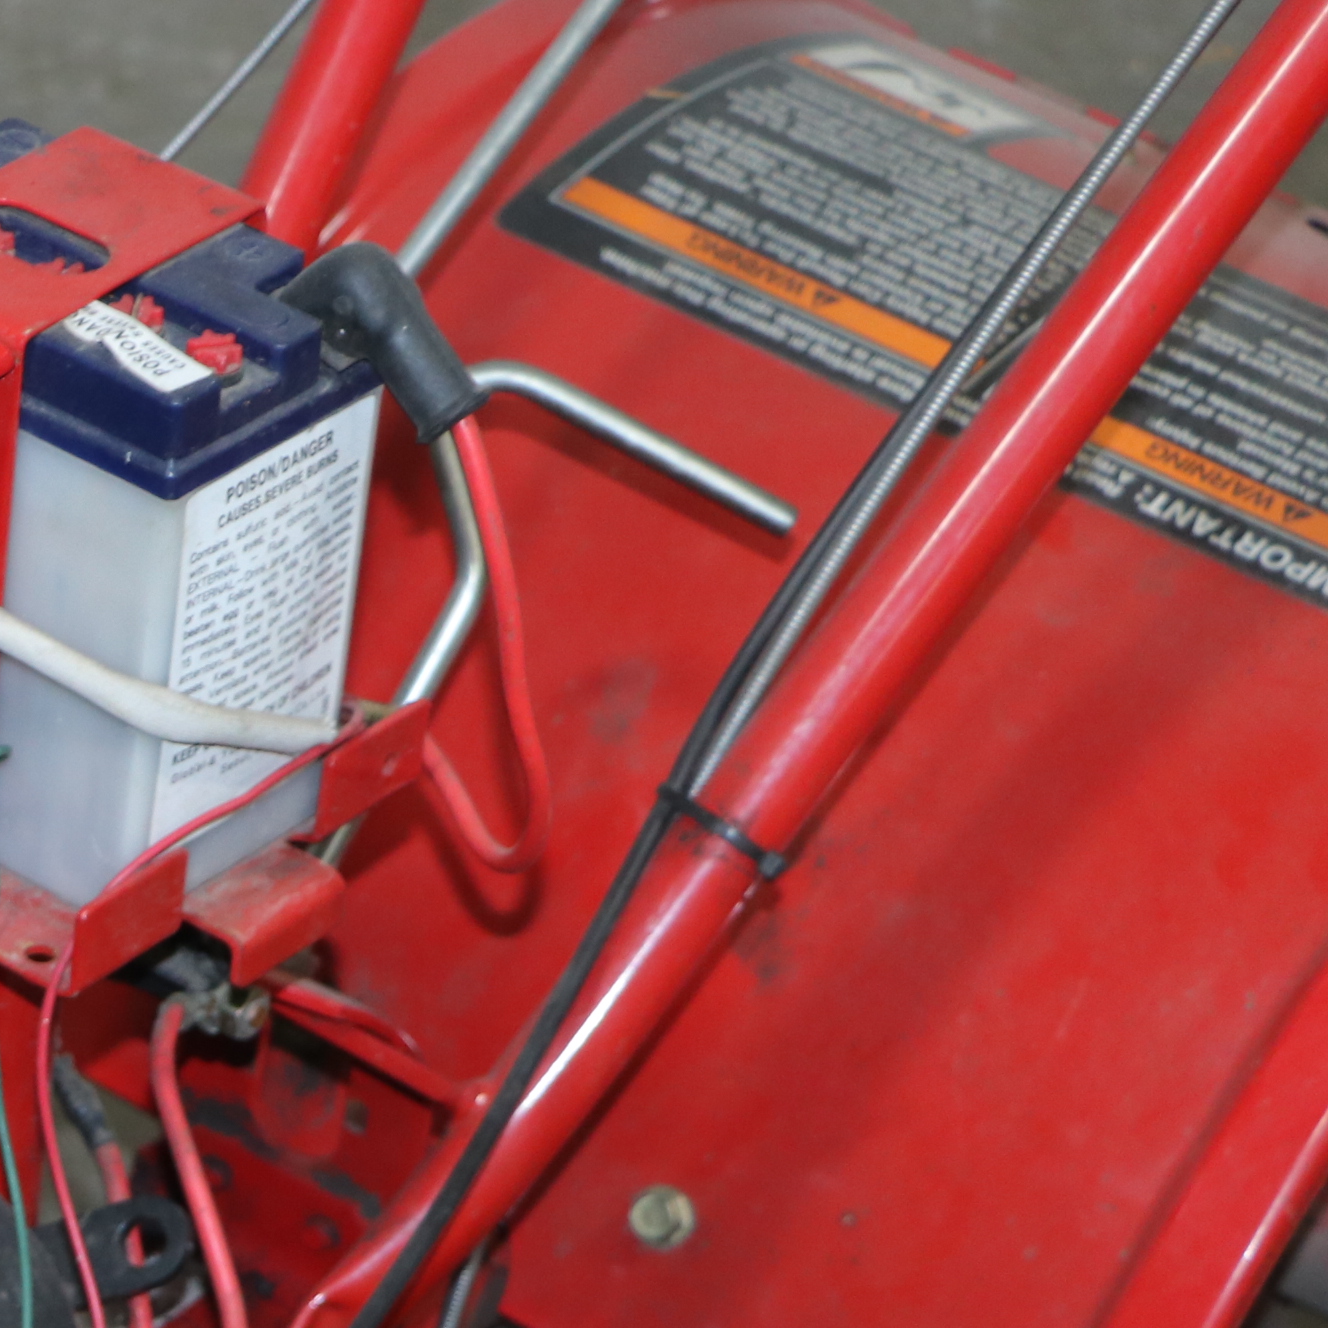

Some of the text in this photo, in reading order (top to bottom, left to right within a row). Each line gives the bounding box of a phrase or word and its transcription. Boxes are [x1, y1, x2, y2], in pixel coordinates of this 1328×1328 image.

[217, 495, 265, 529] CAUSES
[264, 473, 304, 504] SEVERE
[225, 430, 334, 503] POISON/DANGER
[1145, 441, 1275, 511] WARNING
